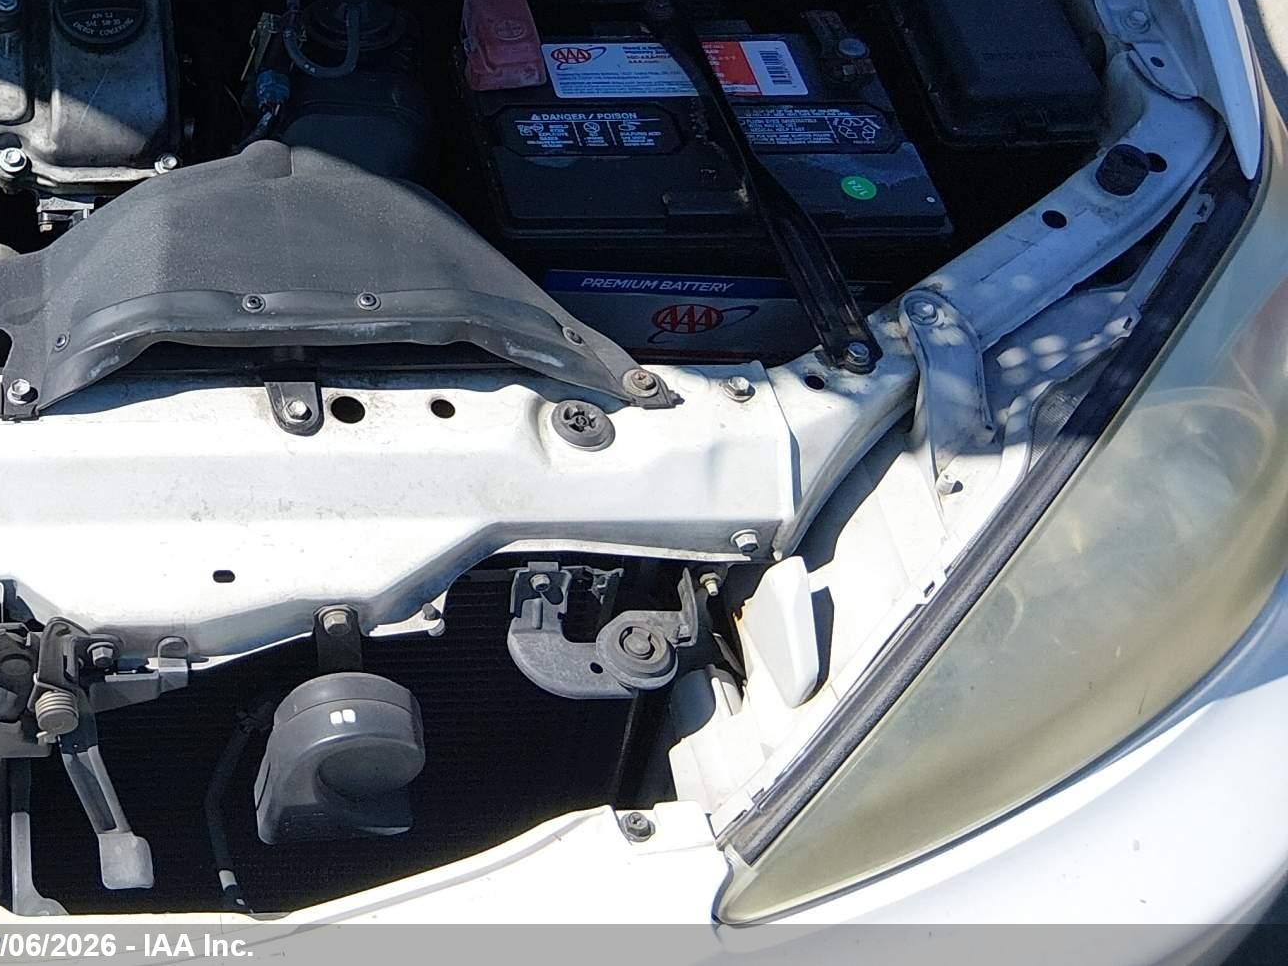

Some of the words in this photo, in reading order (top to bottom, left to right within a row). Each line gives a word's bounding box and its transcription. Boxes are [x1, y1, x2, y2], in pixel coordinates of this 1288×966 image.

[552, 47, 590, 64] AAA
[541, 113, 587, 121] DANGER
[597, 112, 638, 121] POISON
[580, 277, 660, 290] PREMIUM
[659, 279, 735, 293] BATTERY
[655, 304, 721, 333] AAA
